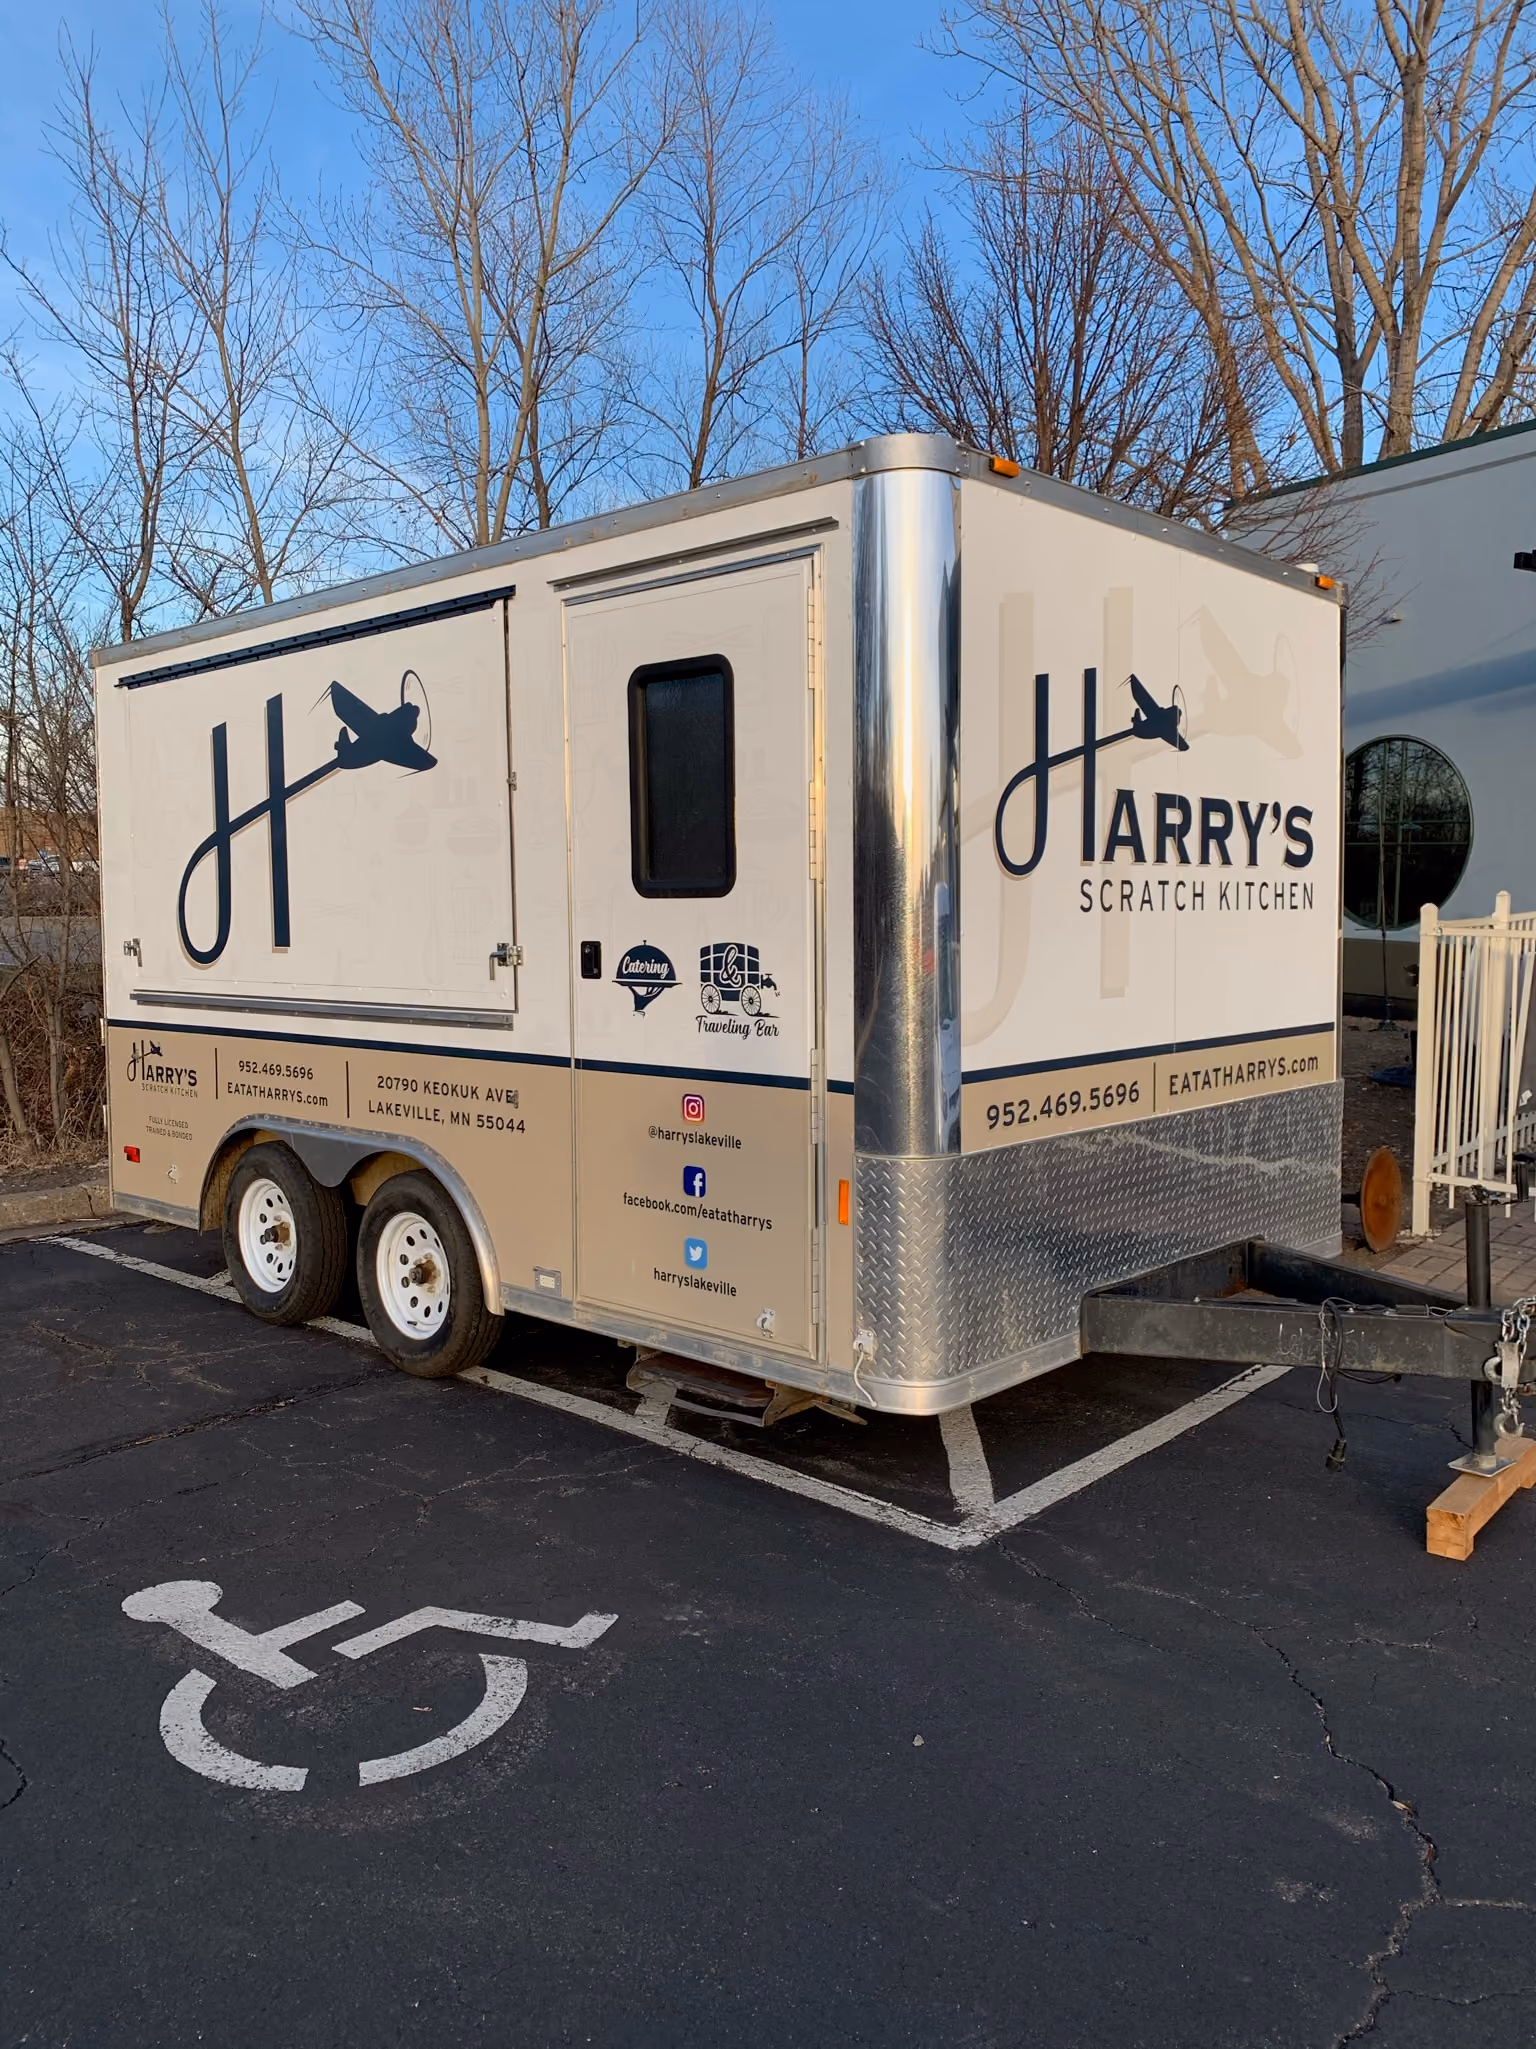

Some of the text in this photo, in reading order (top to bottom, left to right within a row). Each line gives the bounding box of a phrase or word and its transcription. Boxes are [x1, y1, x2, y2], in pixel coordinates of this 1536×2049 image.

[995, 666, 1314, 876] HARRY'S
[178, 692, 340, 964] H
[1079, 878, 1314, 913] SCRATCH KITCHEN
[621, 955, 670, 980] Catering
[720, 944, 743, 987] &
[695, 1015, 780, 1040] Traveling Bar
[126, 1040, 198, 1086] HARRY'S
[238, 1060, 314, 1080] 952.469.5696
[1168, 1054, 1319, 1096] EATATHARRYS.com
[141, 1082, 198, 1098] SCRATCH KITCHEN
[227, 1081, 329, 1107] EATATHARRYS.com
[377, 1075, 419, 1093] 20790
[423, 1080, 480, 1101] KEOKUK
[368, 1099, 526, 1134] LAKEVILLE, MN 55044
[986, 1080, 1140, 1130] 952.469.5696
[149, 1115, 189, 1129] FULLY LICENSED
[171, 1130, 193, 1141] BONDED
[648, 1125, 742, 1149] @harryslakeville
[692, 1172, 704, 1198] f
[623, 1192, 773, 1231] facebook.com/eatatharrys
[653, 1267, 737, 1297] harryslakeville
